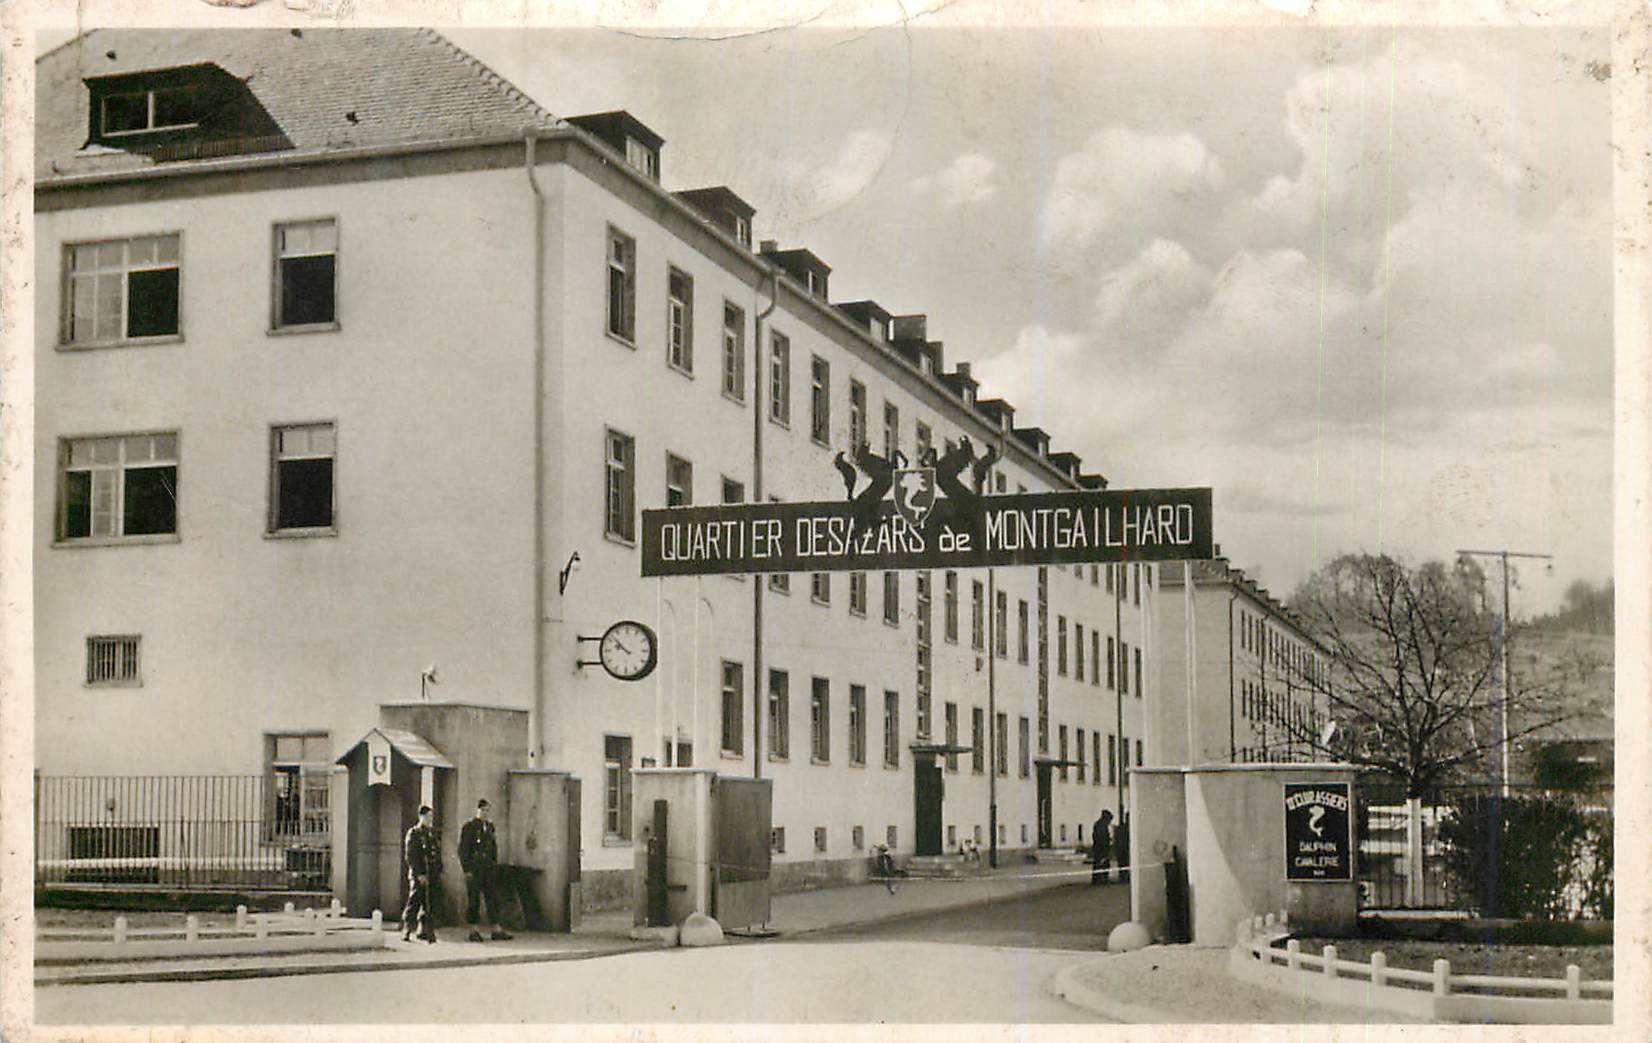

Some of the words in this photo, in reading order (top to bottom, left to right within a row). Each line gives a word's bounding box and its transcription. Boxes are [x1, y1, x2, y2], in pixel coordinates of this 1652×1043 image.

[661, 519, 783, 561] QUARTIER
[939, 525, 971, 551] de
[985, 504, 1193, 551] MONTGAILHARD
